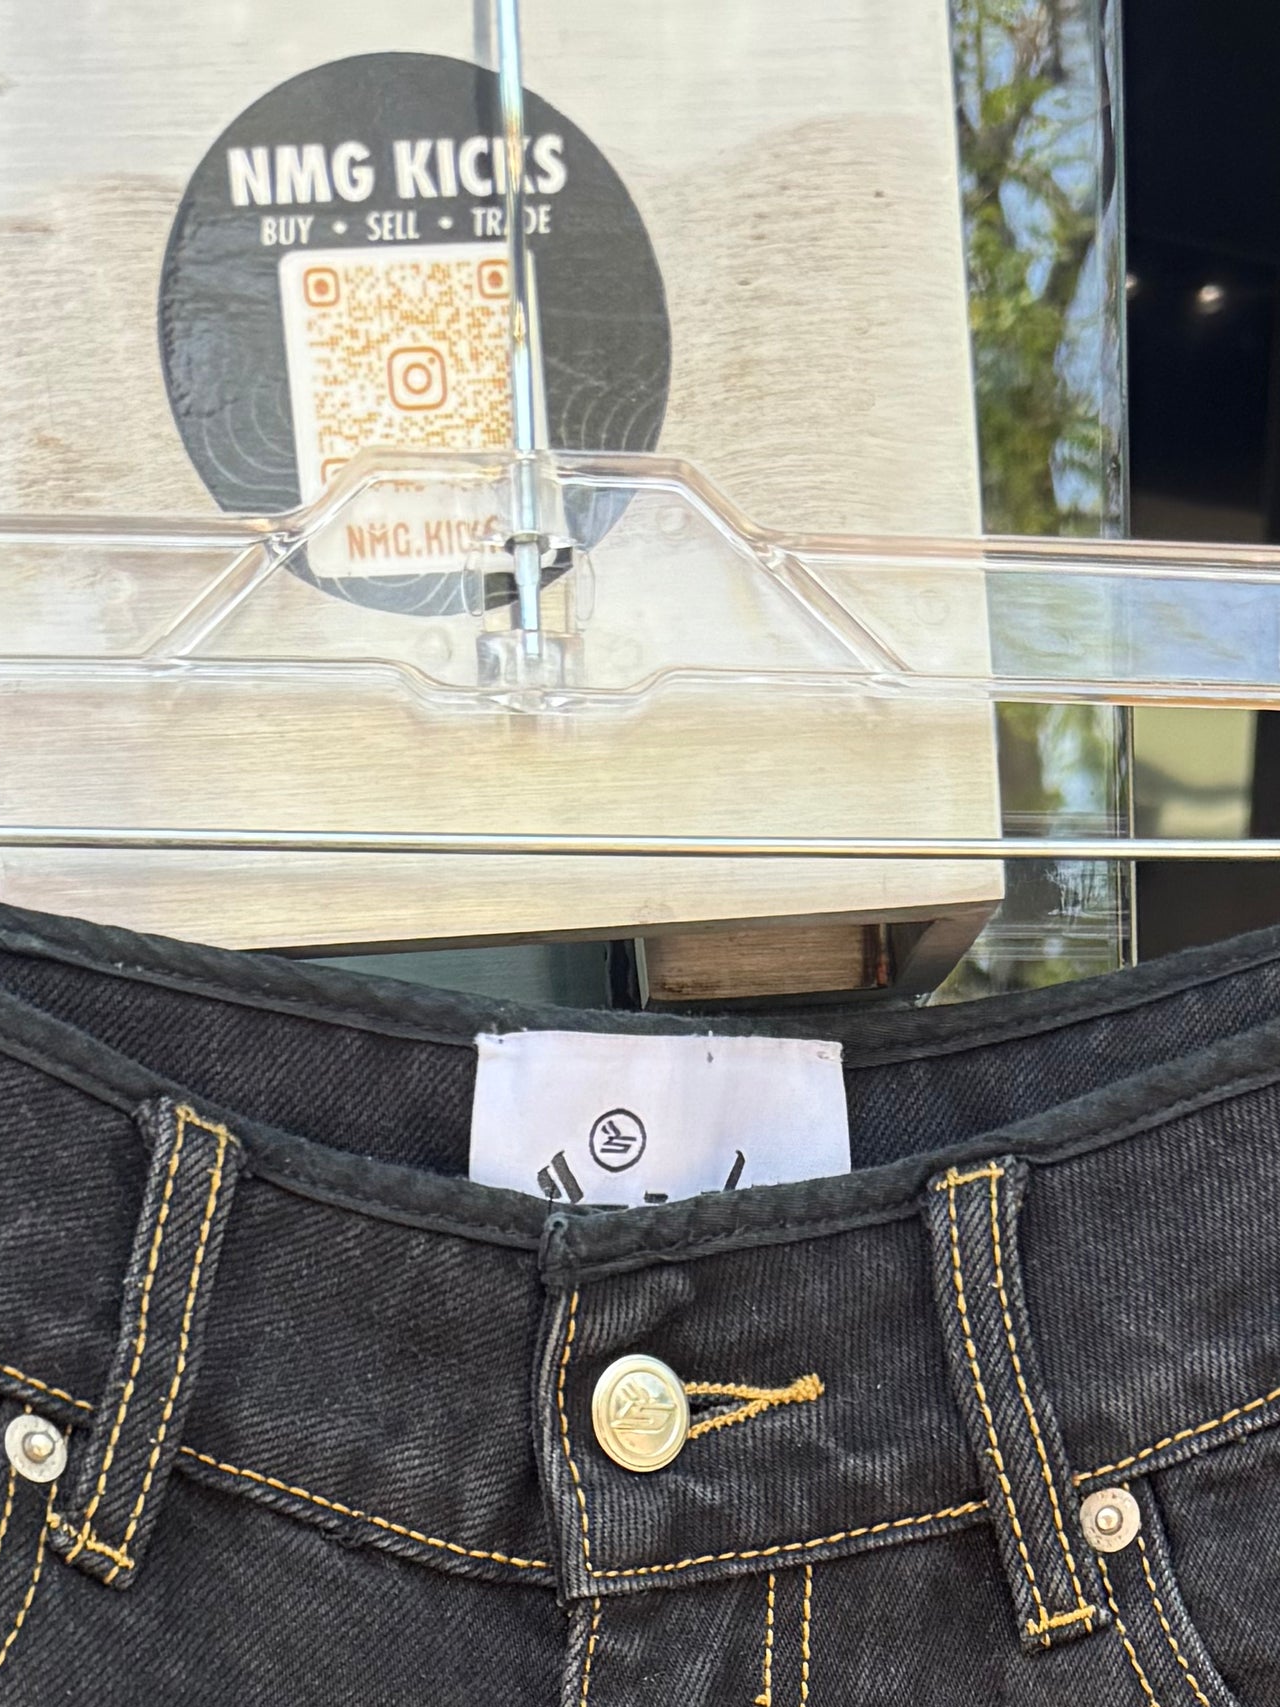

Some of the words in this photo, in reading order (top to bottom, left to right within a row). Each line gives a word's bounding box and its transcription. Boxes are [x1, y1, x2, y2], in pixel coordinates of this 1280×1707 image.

[226, 140, 376, 207] NMG
[392, 132, 568, 200] KICKS
[260, 214, 315, 246] BUY
[366, 209, 420, 241] SELL
[471, 203, 552, 237] TRDE
